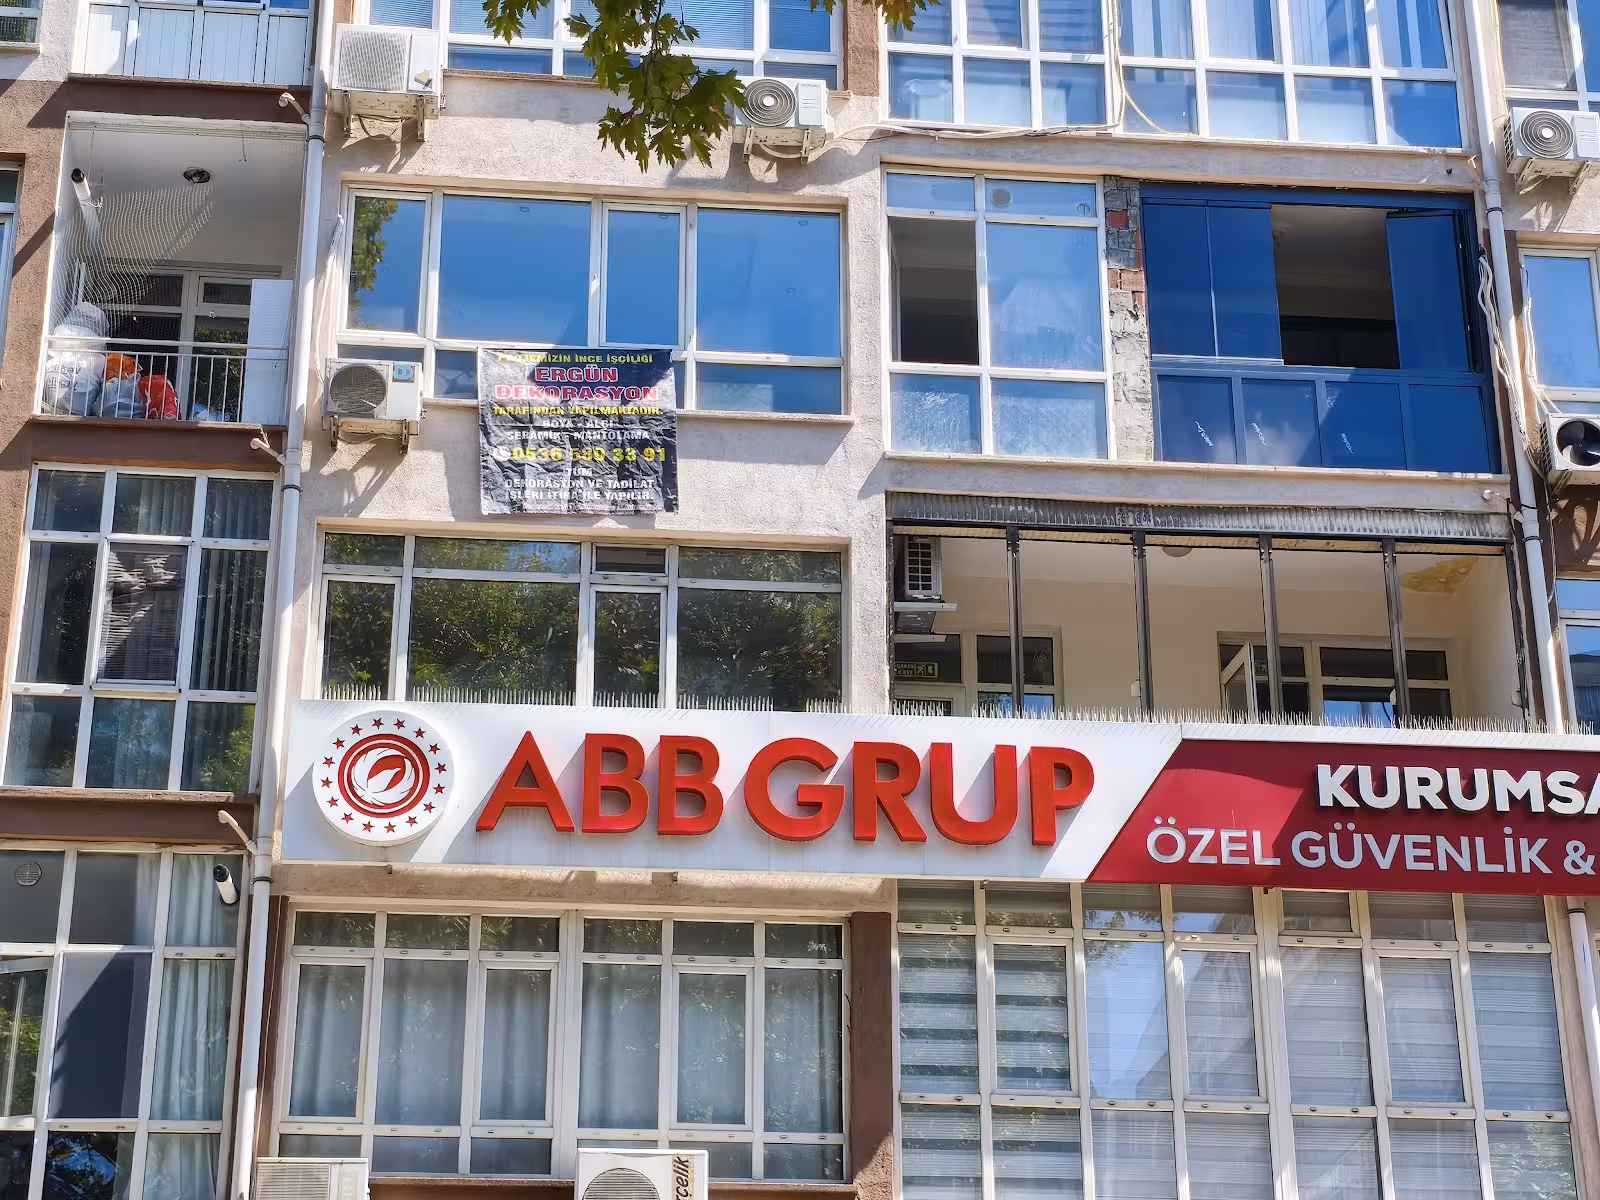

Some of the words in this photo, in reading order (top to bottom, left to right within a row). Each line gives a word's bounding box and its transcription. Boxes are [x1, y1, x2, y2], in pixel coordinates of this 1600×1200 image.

[575, 353, 603, 363] İNCE
[606, 353, 653, 364] İŞÇİLİĞİ
[535, 364, 618, 383] ERGÜN
[494, 384, 659, 401] DEKORASYON
[511, 447, 563, 462] 0536
[612, 447, 637, 462] 33
[643, 447, 666, 462] 91
[475, 730, 725, 837] ABB
[743, 737, 1095, 847] GRUP
[1146, 815, 1281, 867] ÖZEL
[1290, 821, 1553, 875] GÜVENLİK
[1563, 839, 1597, 876] &
